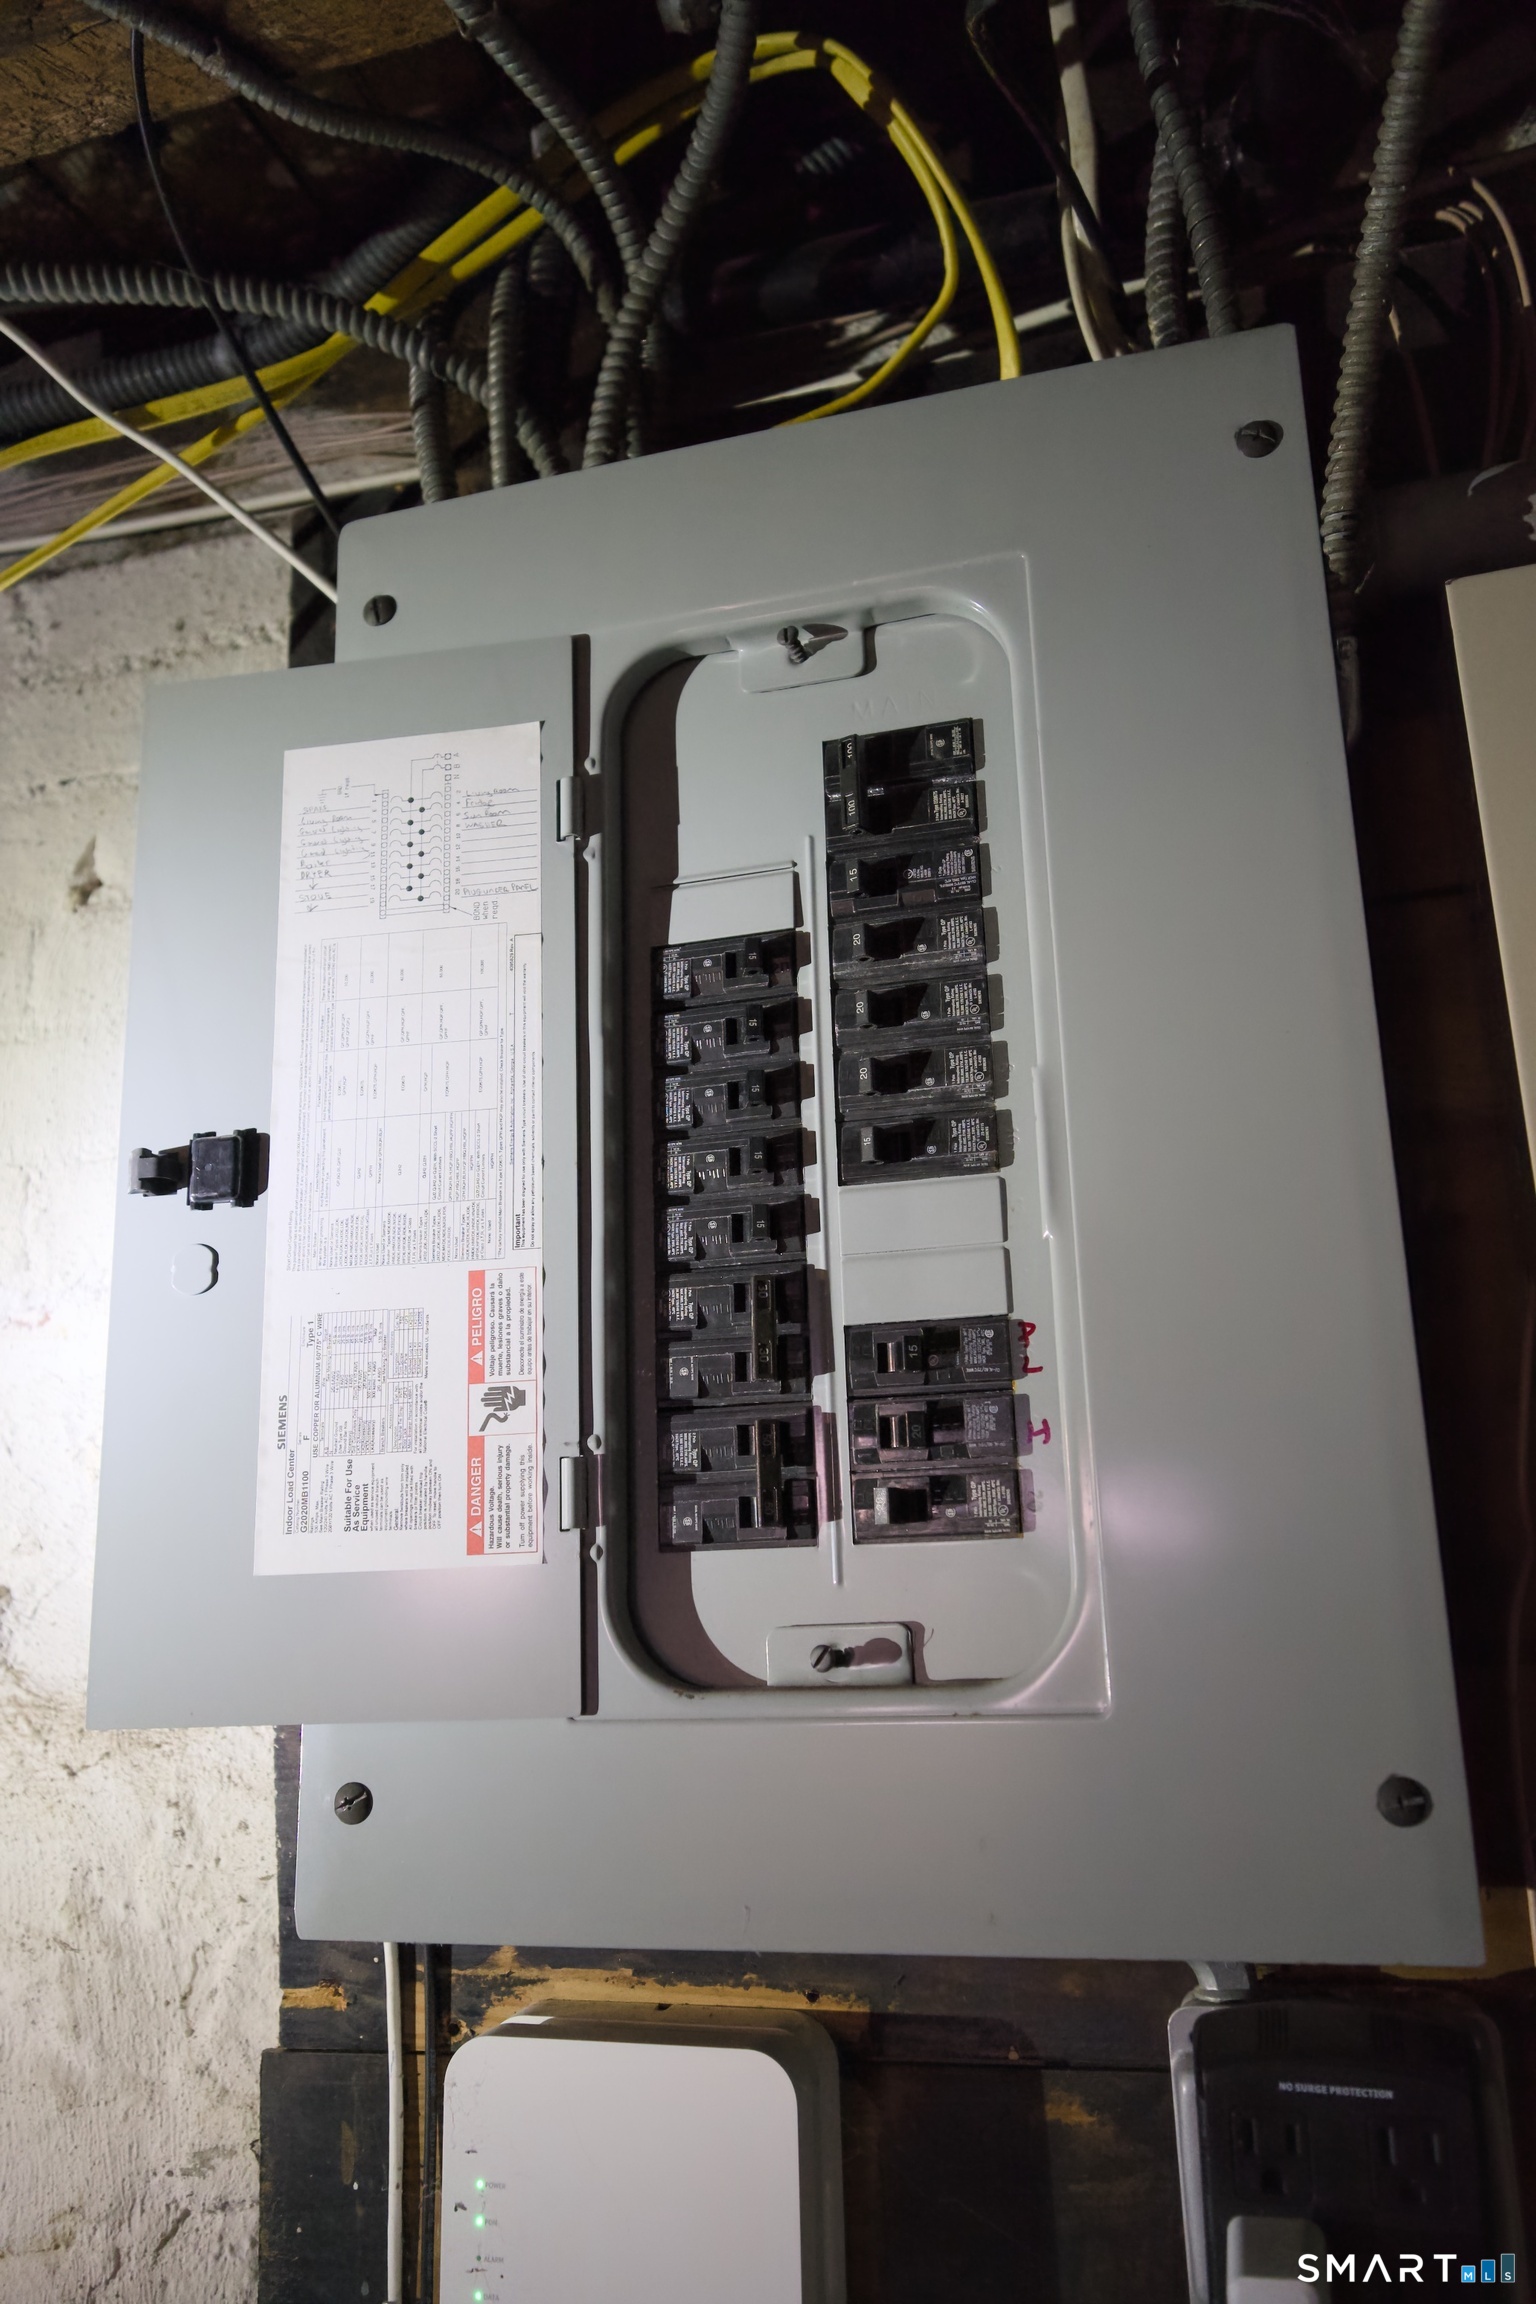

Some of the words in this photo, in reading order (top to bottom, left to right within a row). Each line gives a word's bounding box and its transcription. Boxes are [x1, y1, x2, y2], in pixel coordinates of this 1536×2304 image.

[847, 800, 855, 816] 100
[849, 869, 857, 881] 15
[853, 934, 860, 945] 20
[748, 952, 757, 960] 15
[857, 1002, 864, 1013] 20
[749, 1018, 757, 1027] 15
[860, 1068, 868, 1080] 20
[751, 1084, 760, 1092] 15
[864, 1137, 870, 1146] 15
[754, 1151, 762, 1159] 15
[756, 1220, 765, 1228] 15
[472, 1288, 482, 1346] PELIGRO
[307, 1328, 315, 1348] Type
[909, 1345, 918, 1358] 15
[314, 1401, 319, 1411] OR
[277, 1395, 287, 1450] SIEMENS
[912, 1425, 920, 1438] 20
[287, 1449, 295, 1478] Center
[345, 1459, 353, 1476] Use
[286, 1481, 294, 1503] Load
[471, 1457, 481, 1516] DANGER
[361, 1483, 369, 1531] Equipment
[285, 1506, 293, 1535] Indoor
[344, 1496, 352, 1532] Suitable
[353, 1520, 360, 1532] As
[1279, 2081, 1293, 2091] NO
[1294, 2083, 1328, 2094] SURGE
[1329, 2084, 1394, 2099] PROTECTION
